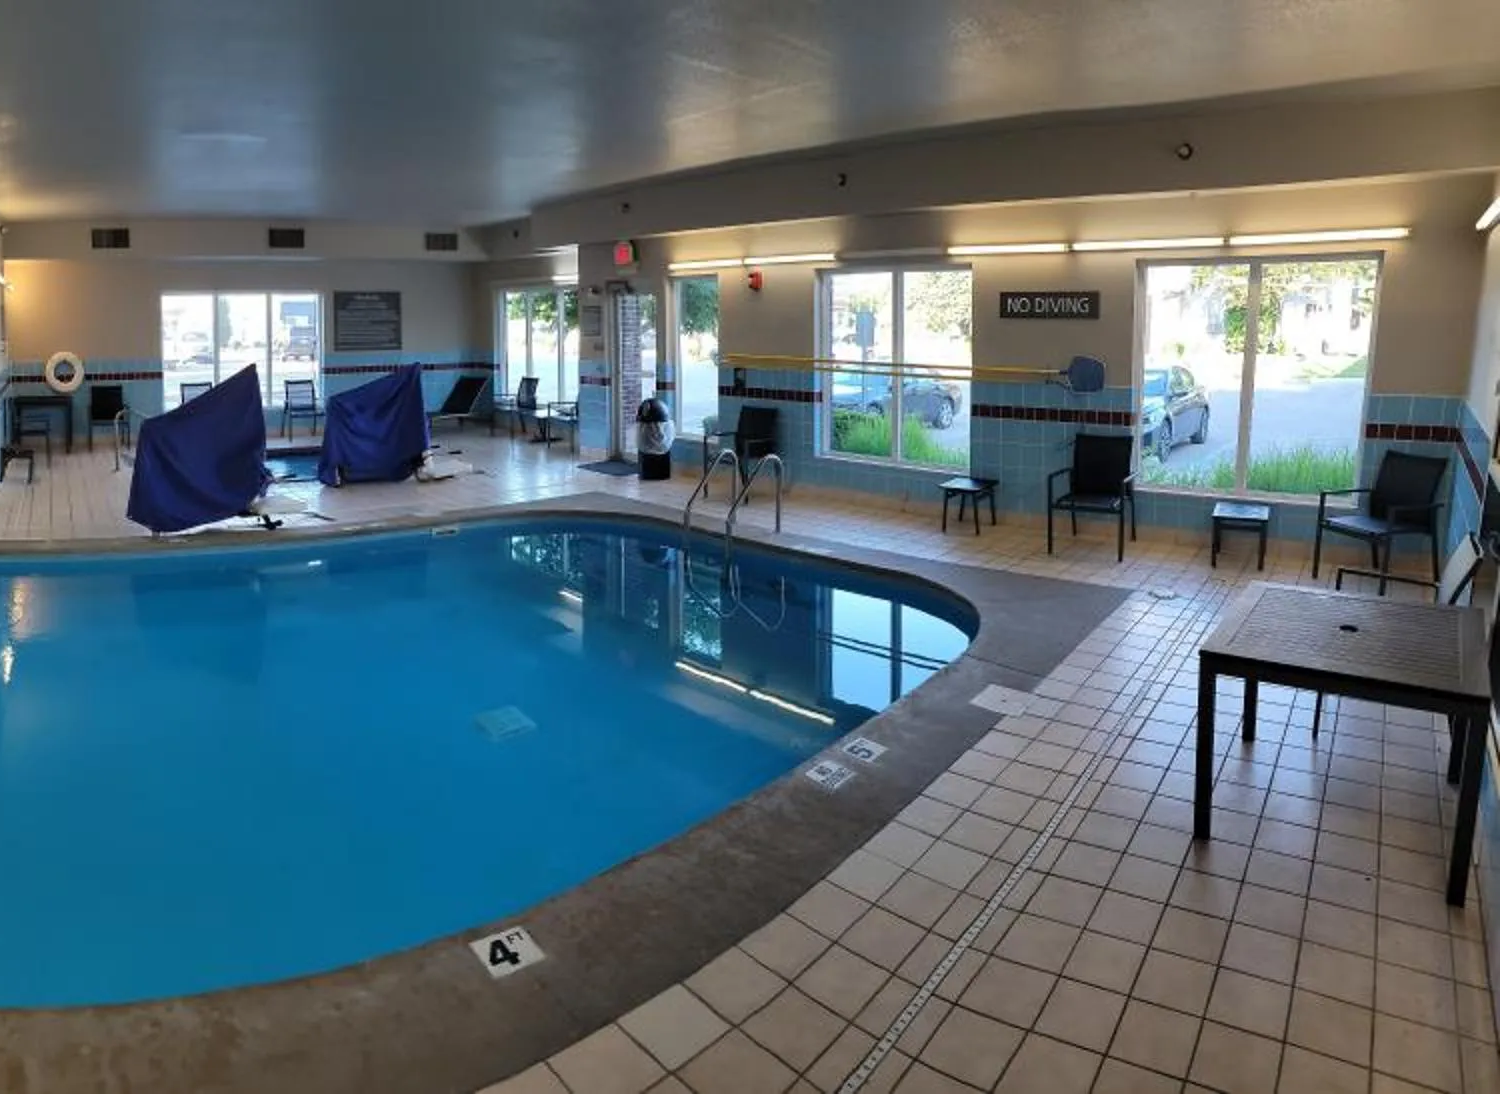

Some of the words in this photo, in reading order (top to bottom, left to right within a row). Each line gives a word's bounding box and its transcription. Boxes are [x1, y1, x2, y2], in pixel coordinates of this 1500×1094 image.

[1007, 297, 1031, 313] NO
[1035, 297, 1090, 313] DIVING
[489, 939, 520, 967] 4
[505, 931, 524, 945] FT
